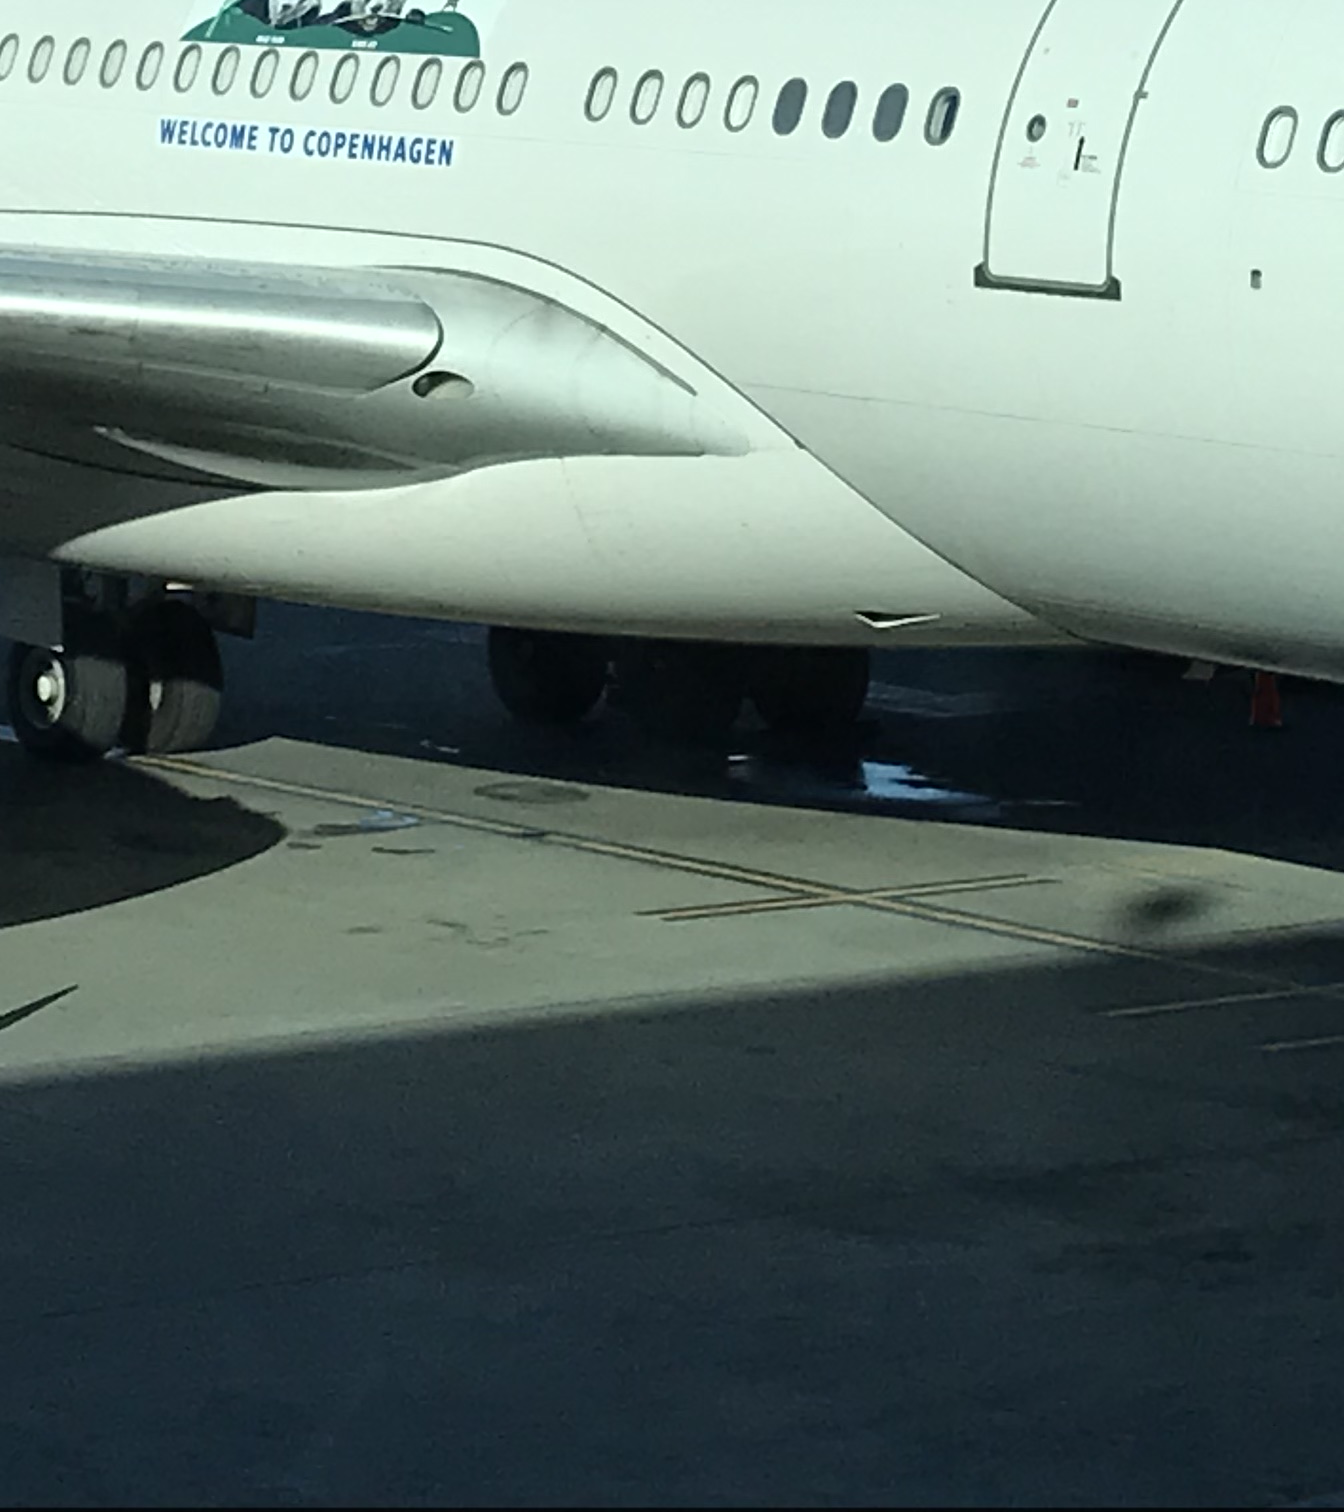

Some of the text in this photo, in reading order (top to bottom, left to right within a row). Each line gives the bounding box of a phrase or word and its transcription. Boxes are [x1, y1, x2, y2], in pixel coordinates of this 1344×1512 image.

[160, 119, 454, 167] WELCOME TO COPENHAGEN
